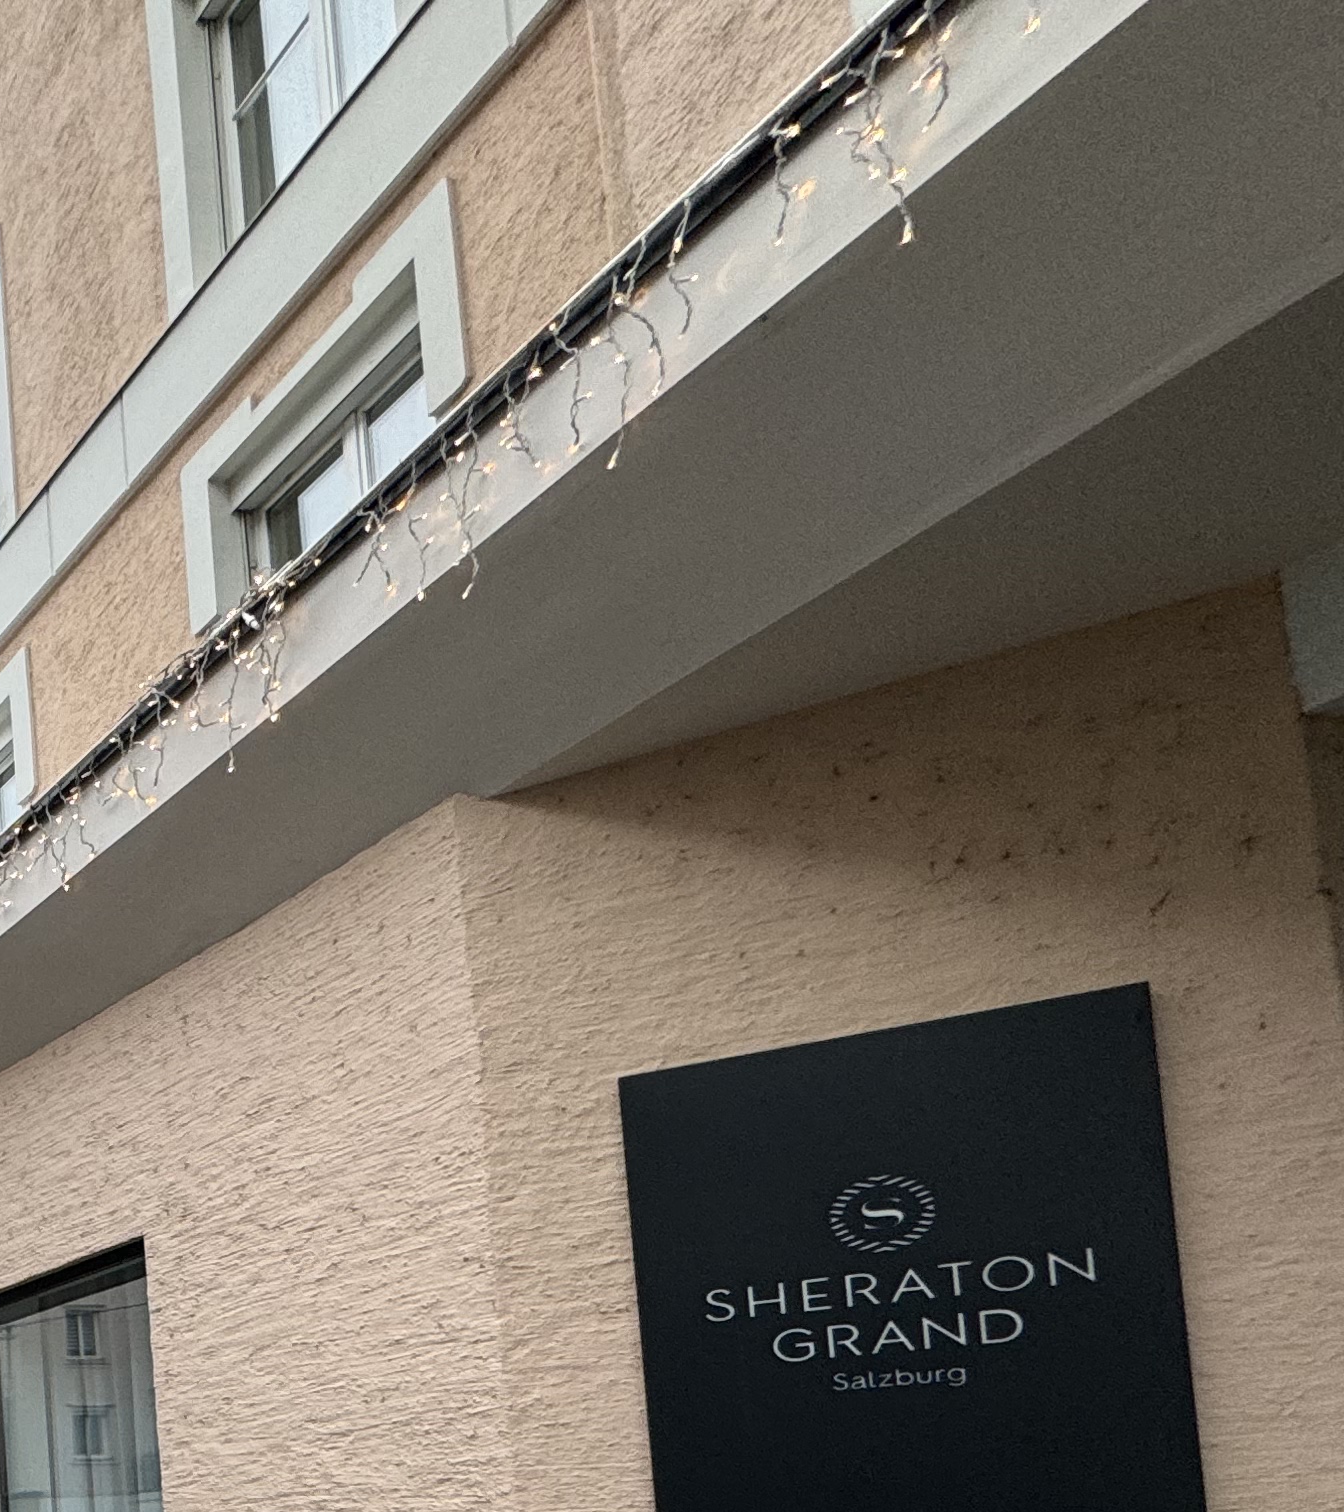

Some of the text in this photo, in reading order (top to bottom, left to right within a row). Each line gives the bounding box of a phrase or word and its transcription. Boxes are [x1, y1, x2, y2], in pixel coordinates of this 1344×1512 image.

[705, 1247, 1096, 1322] SHERATON
[772, 1308, 1023, 1362] GRAND
[832, 1366, 967, 1391] Salzburg
